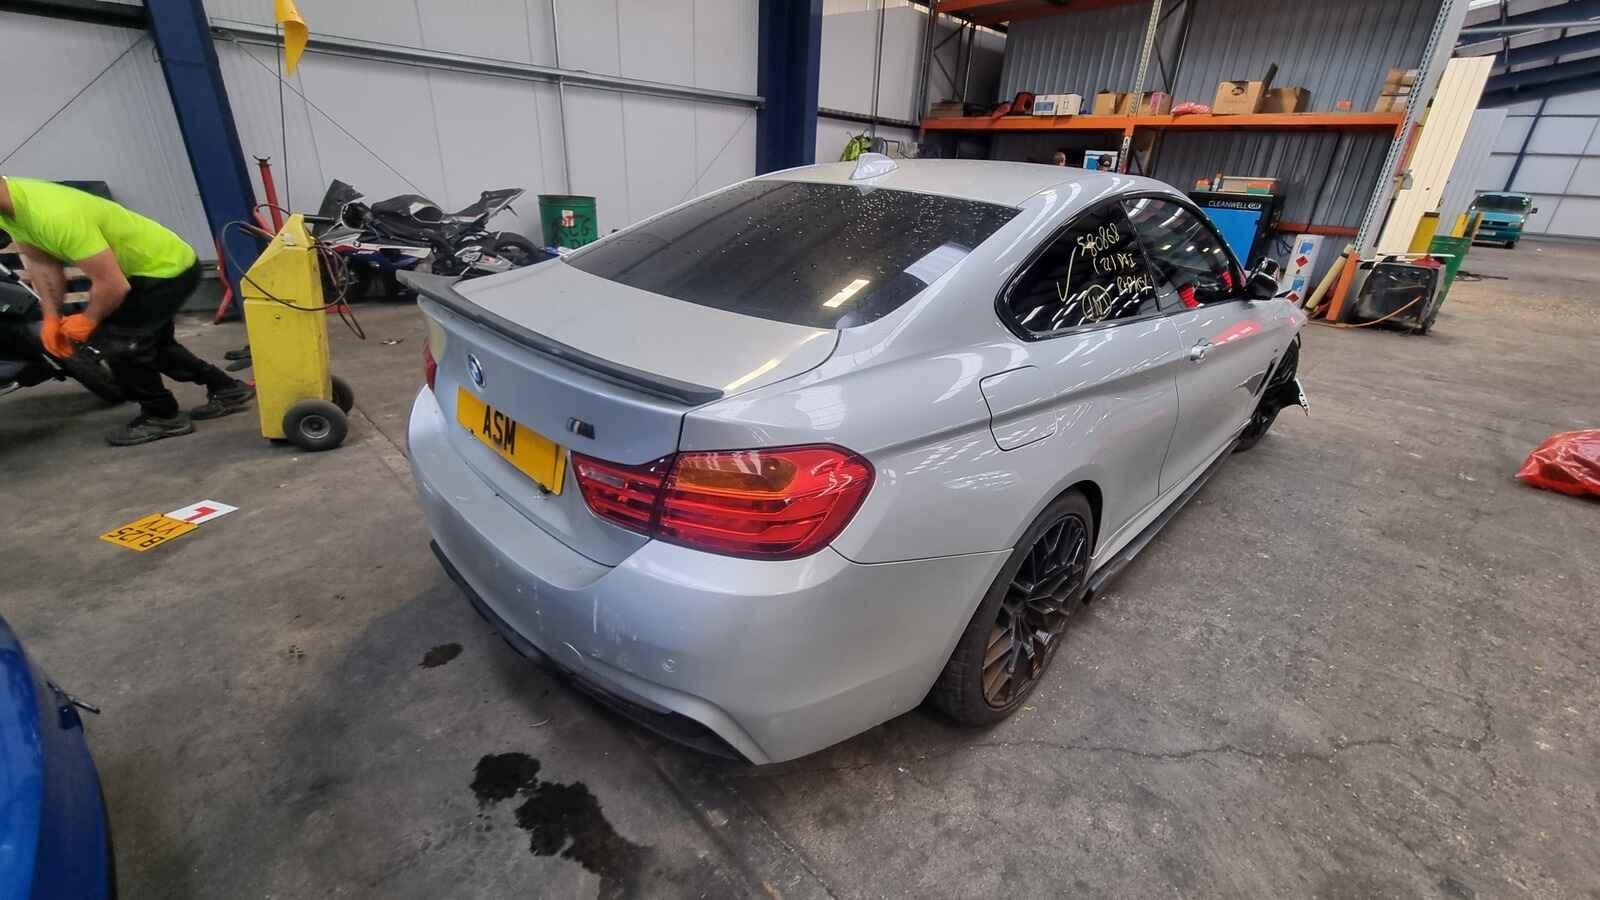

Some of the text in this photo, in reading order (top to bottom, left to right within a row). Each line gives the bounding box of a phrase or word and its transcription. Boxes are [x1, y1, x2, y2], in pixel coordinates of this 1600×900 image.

[1208, 200, 1248, 209] CLEANWELL
[482, 404, 517, 455] ASM
[183, 506, 218, 522] L
